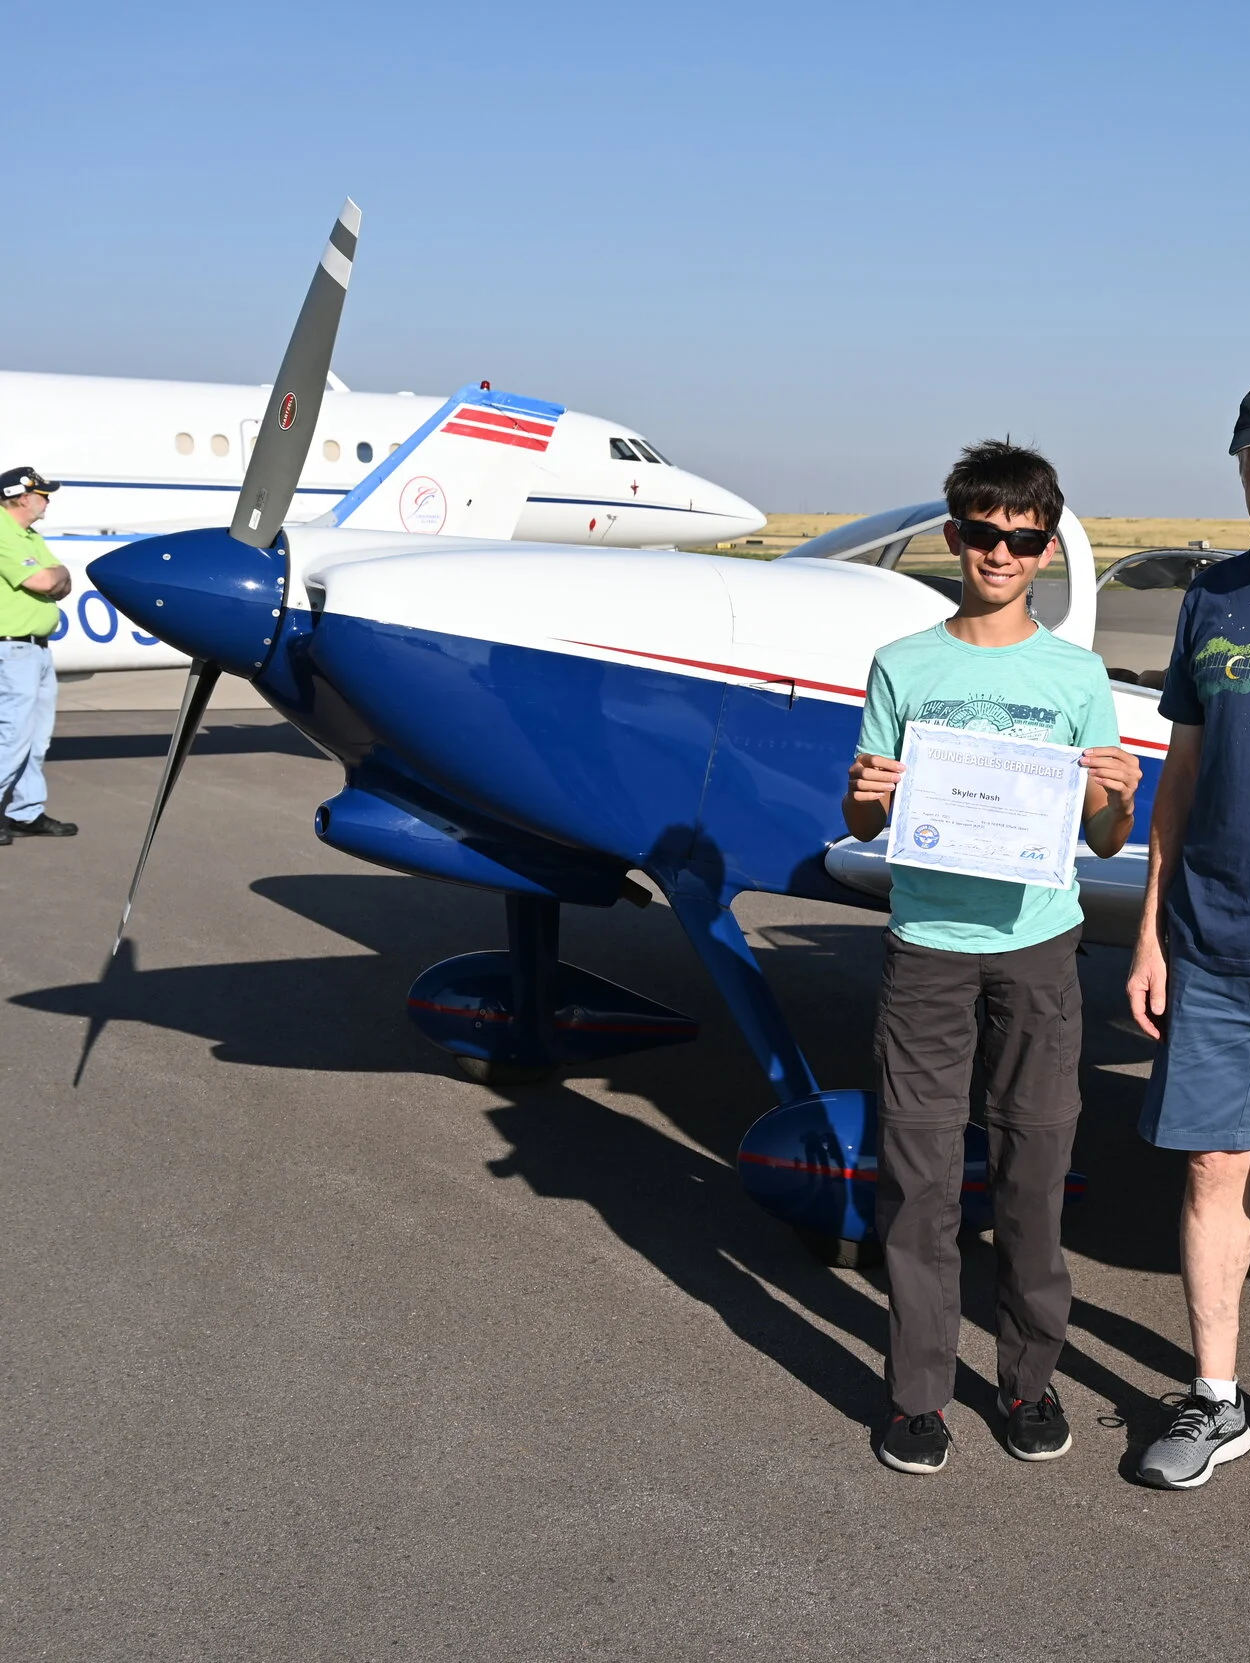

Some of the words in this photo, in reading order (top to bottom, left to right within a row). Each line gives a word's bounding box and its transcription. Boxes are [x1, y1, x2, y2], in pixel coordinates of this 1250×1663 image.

[927, 748, 963, 763] YOUNG
[964, 753, 1002, 769] EAGLES
[1003, 760, 1064, 779] CERTIFICATE
[951, 788, 977, 799] Skyler
[979, 792, 1000, 802] Nash
[1019, 850, 1045, 860] EAA
